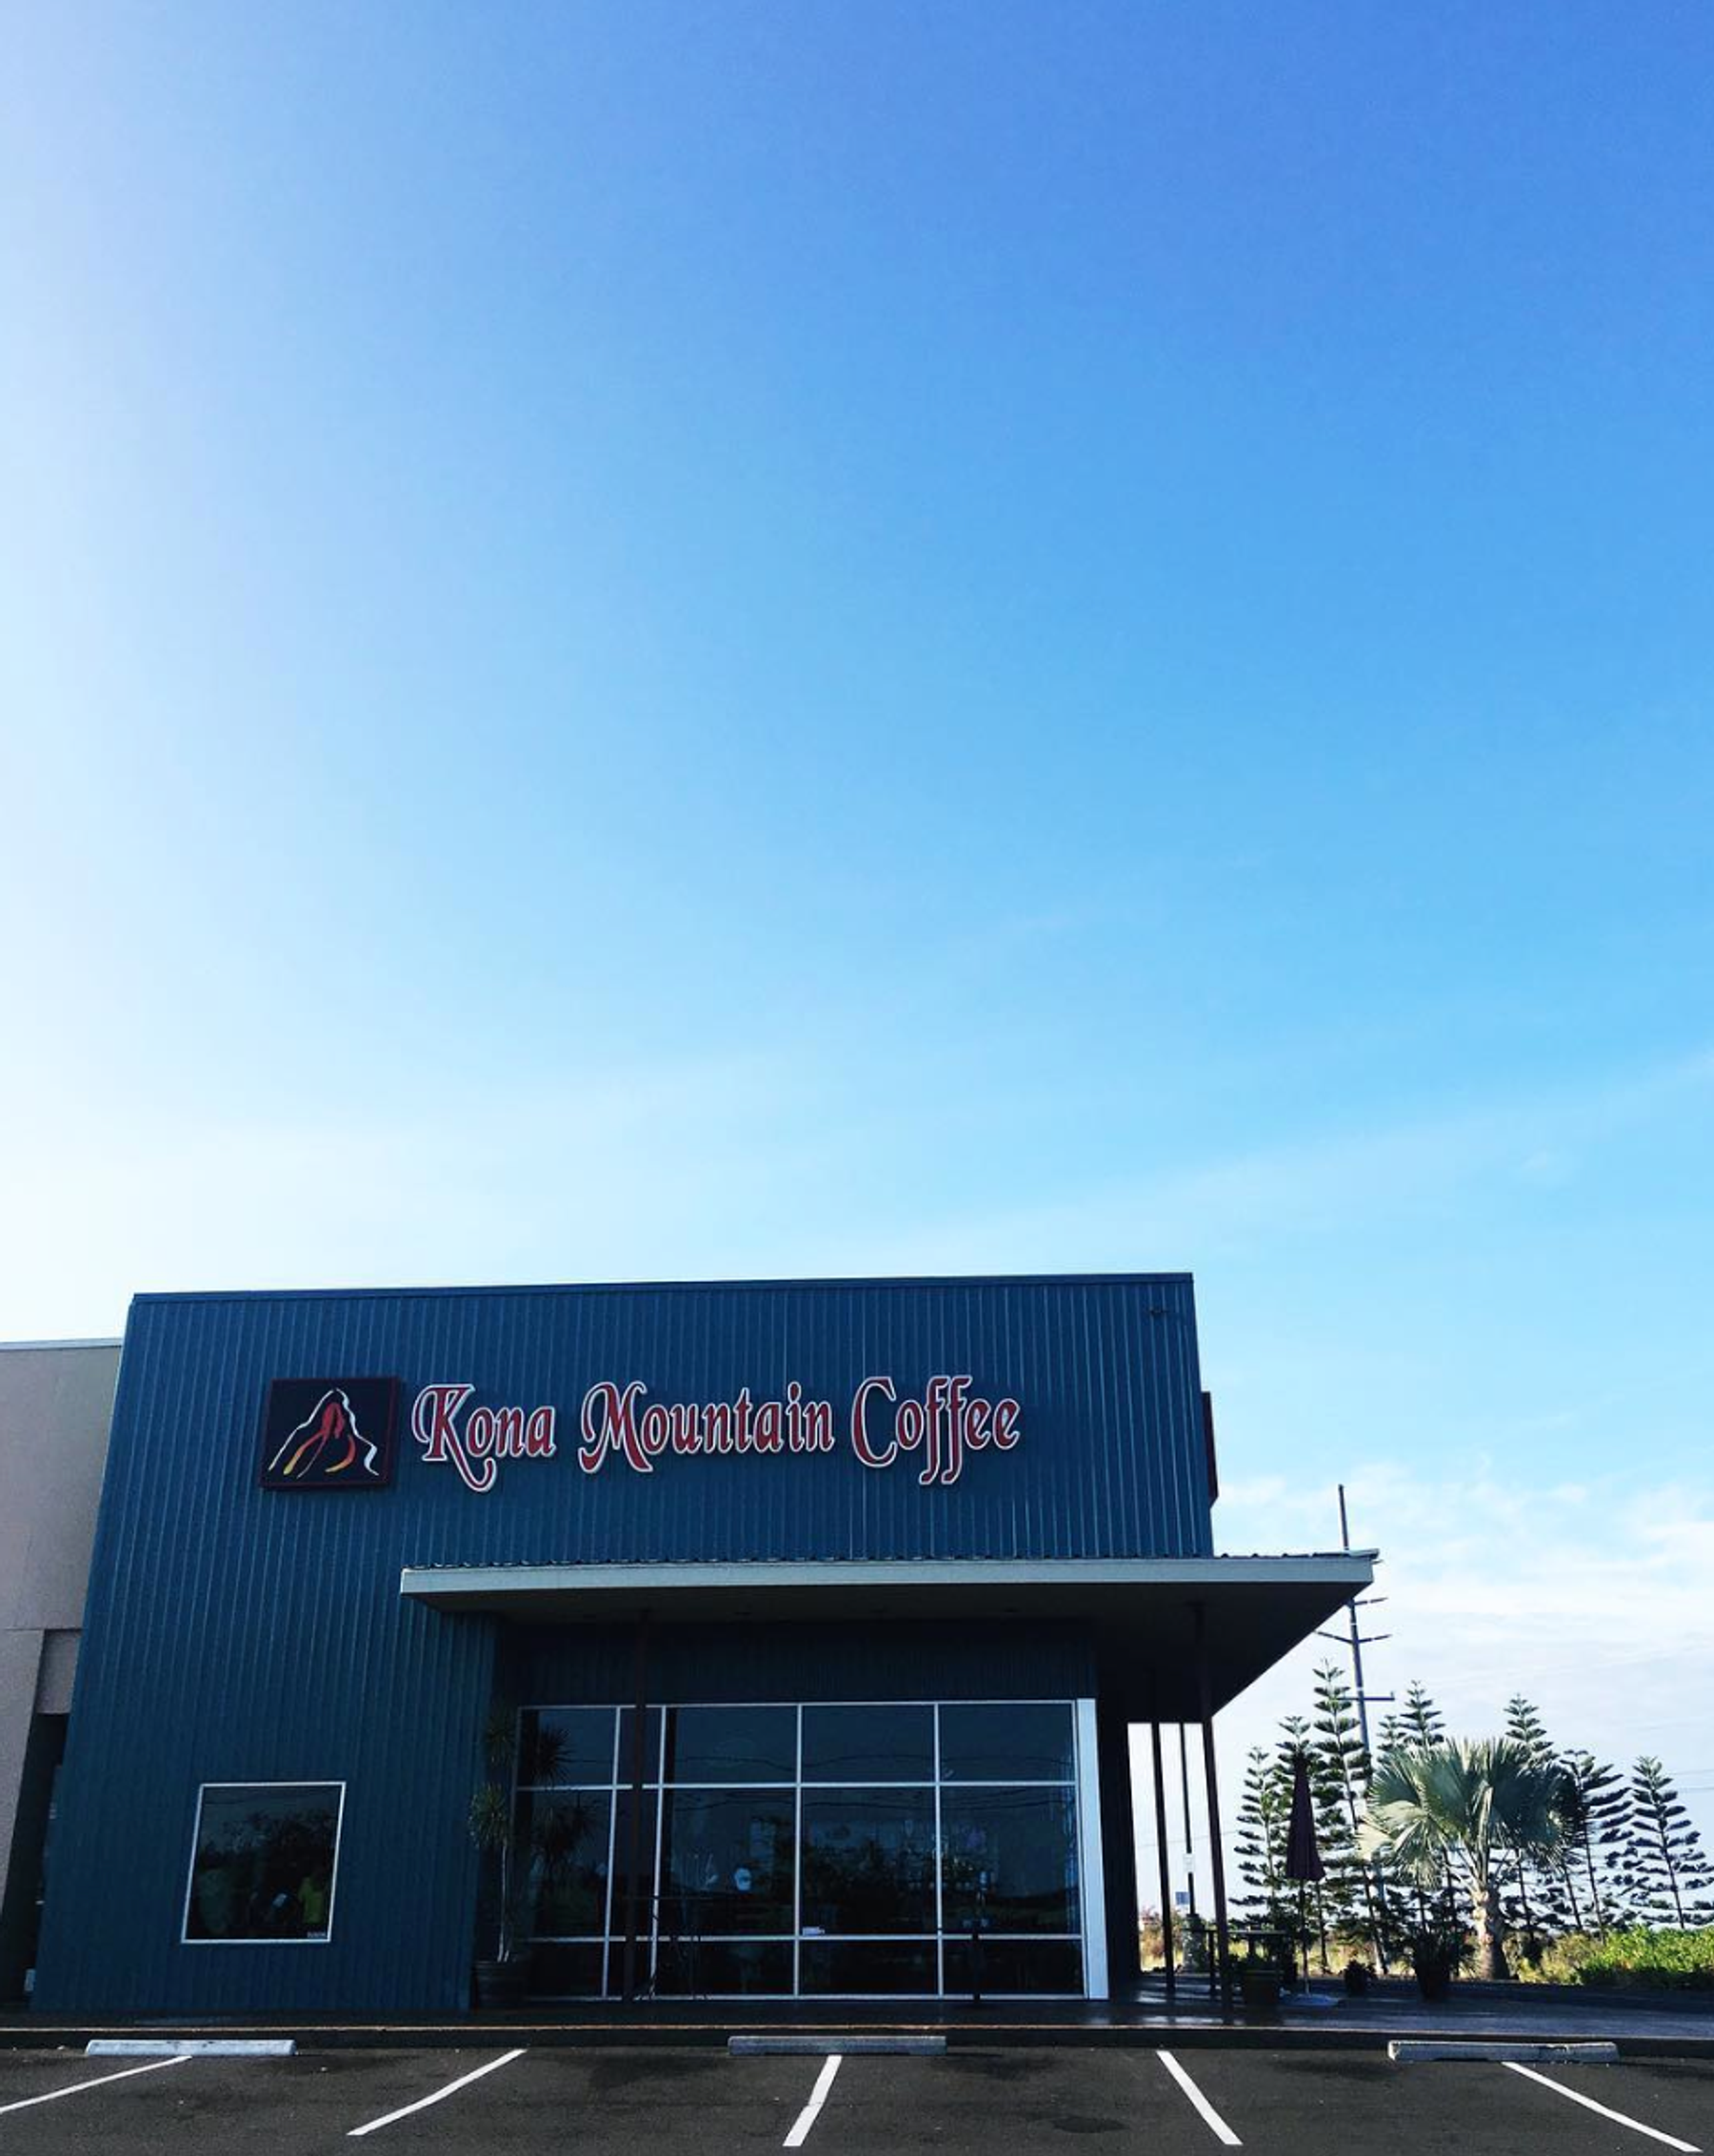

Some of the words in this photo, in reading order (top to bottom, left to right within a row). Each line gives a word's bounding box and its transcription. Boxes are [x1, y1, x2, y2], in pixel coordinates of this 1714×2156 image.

[411, 1384, 556, 1492] Kona
[578, 1381, 834, 1472] Mountain
[851, 1375, 1021, 1486] Coffee
